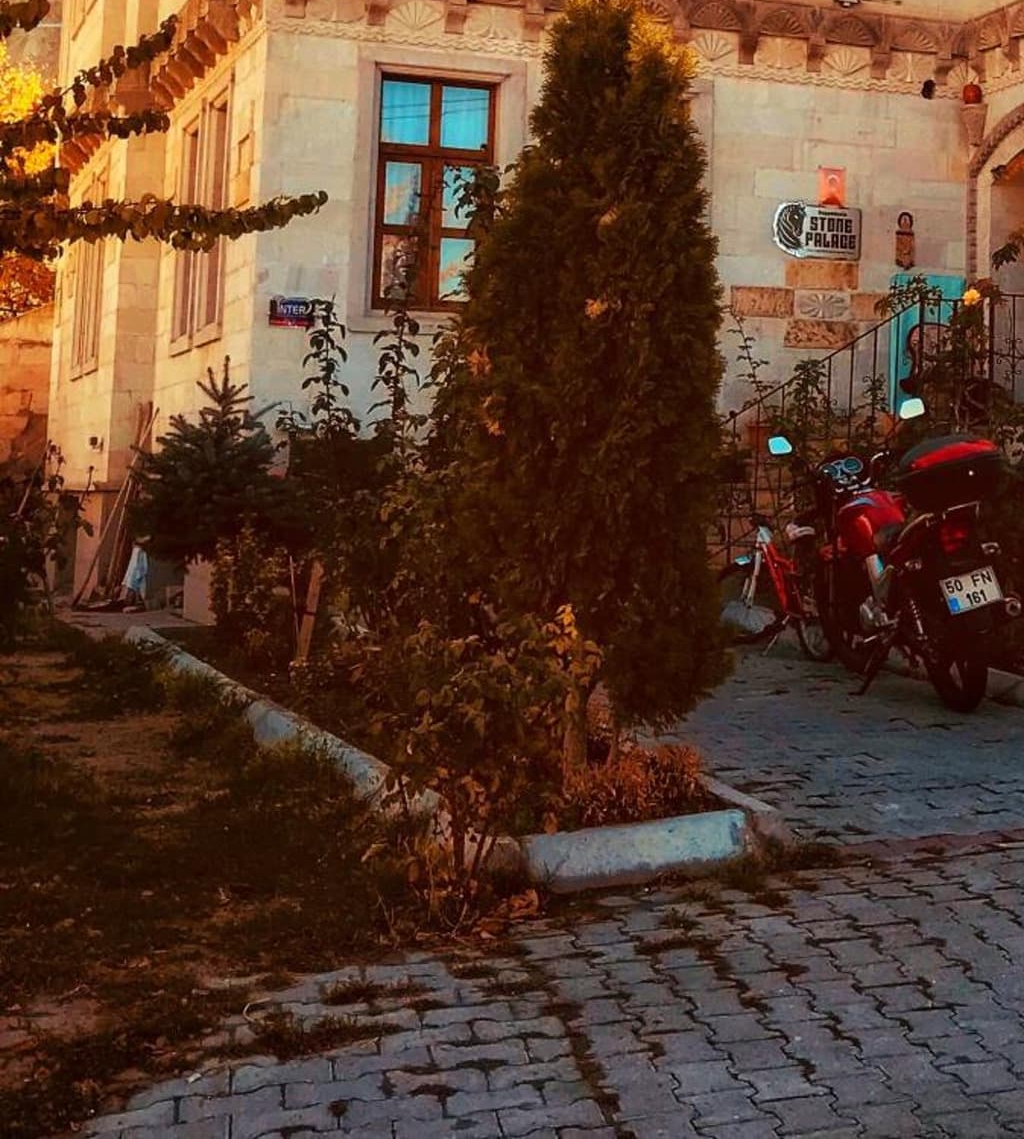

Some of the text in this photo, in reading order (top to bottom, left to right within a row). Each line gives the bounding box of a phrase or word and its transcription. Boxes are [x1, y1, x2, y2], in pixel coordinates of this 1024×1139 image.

[810, 216, 853, 234] STONE
[805, 231, 857, 250] PALACE
[945, 570, 992, 594] 50 FN
[966, 589, 987, 605] 161
